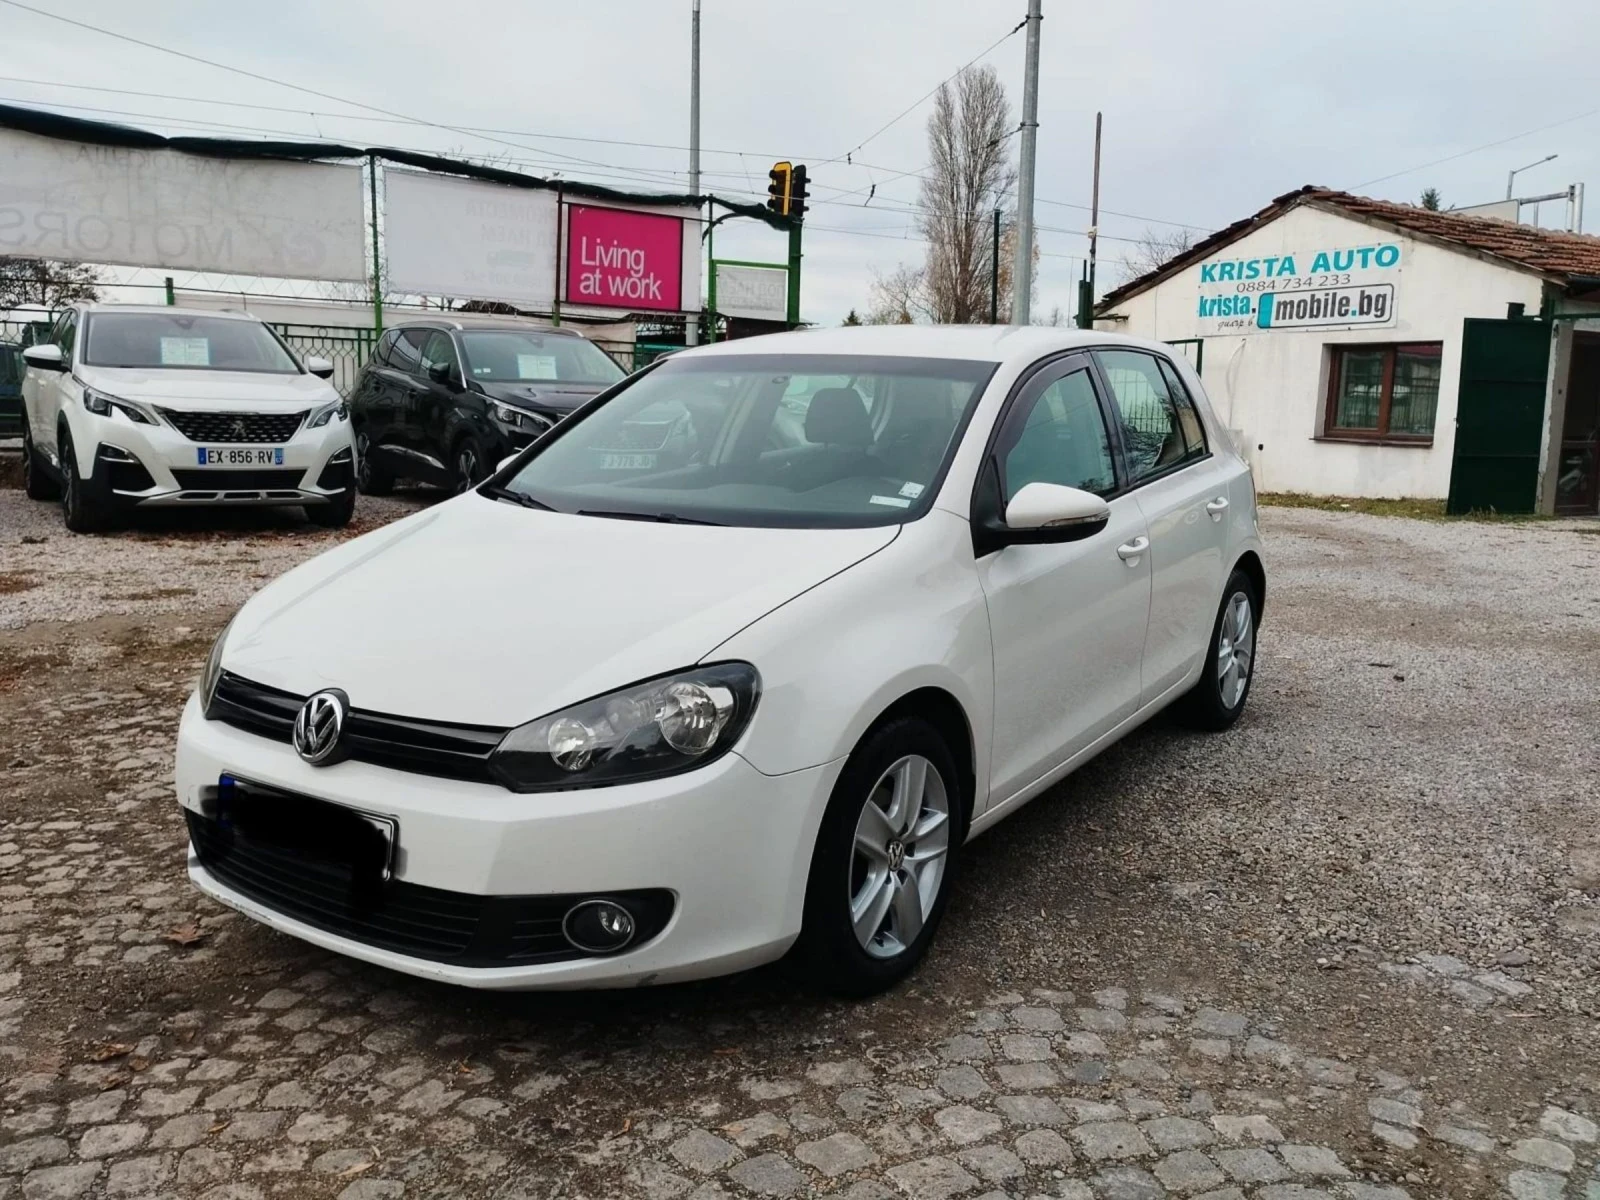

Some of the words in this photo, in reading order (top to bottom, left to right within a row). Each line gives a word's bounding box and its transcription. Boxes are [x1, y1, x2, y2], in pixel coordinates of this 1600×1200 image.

[581, 236, 645, 278] Living
[1201, 256, 1296, 283] KRISTA
[1310, 245, 1400, 274] AUTO
[580, 268, 602, 295] at
[608, 272, 662, 301] work
[1236, 280, 1277, 293] 0884
[1282, 277, 1312, 290] 734
[1318, 273, 1351, 287] 233
[1275, 290, 1388, 321] mobile.bg
